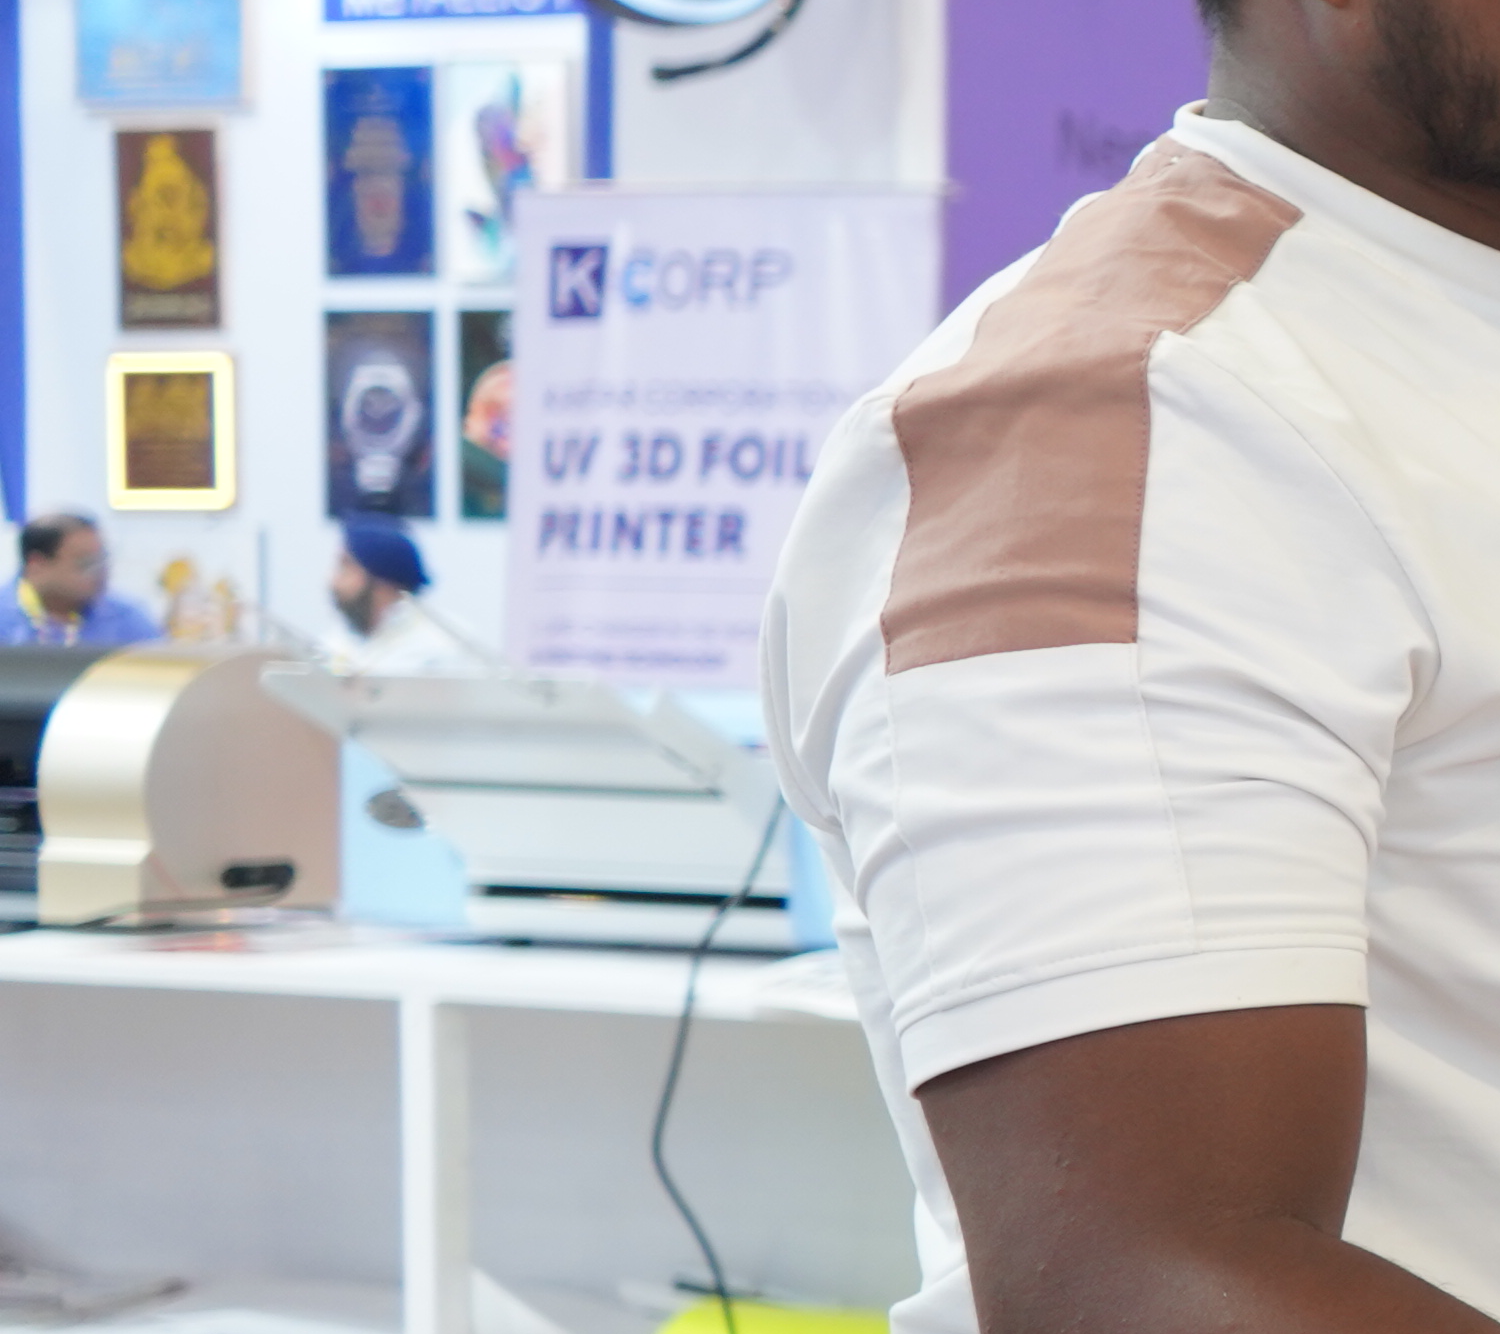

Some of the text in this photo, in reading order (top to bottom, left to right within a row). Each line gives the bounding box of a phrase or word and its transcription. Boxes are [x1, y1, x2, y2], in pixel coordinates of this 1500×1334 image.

[542, 429, 813, 485] UV 3D FOIL
[539, 506, 747, 559] PRINTER
